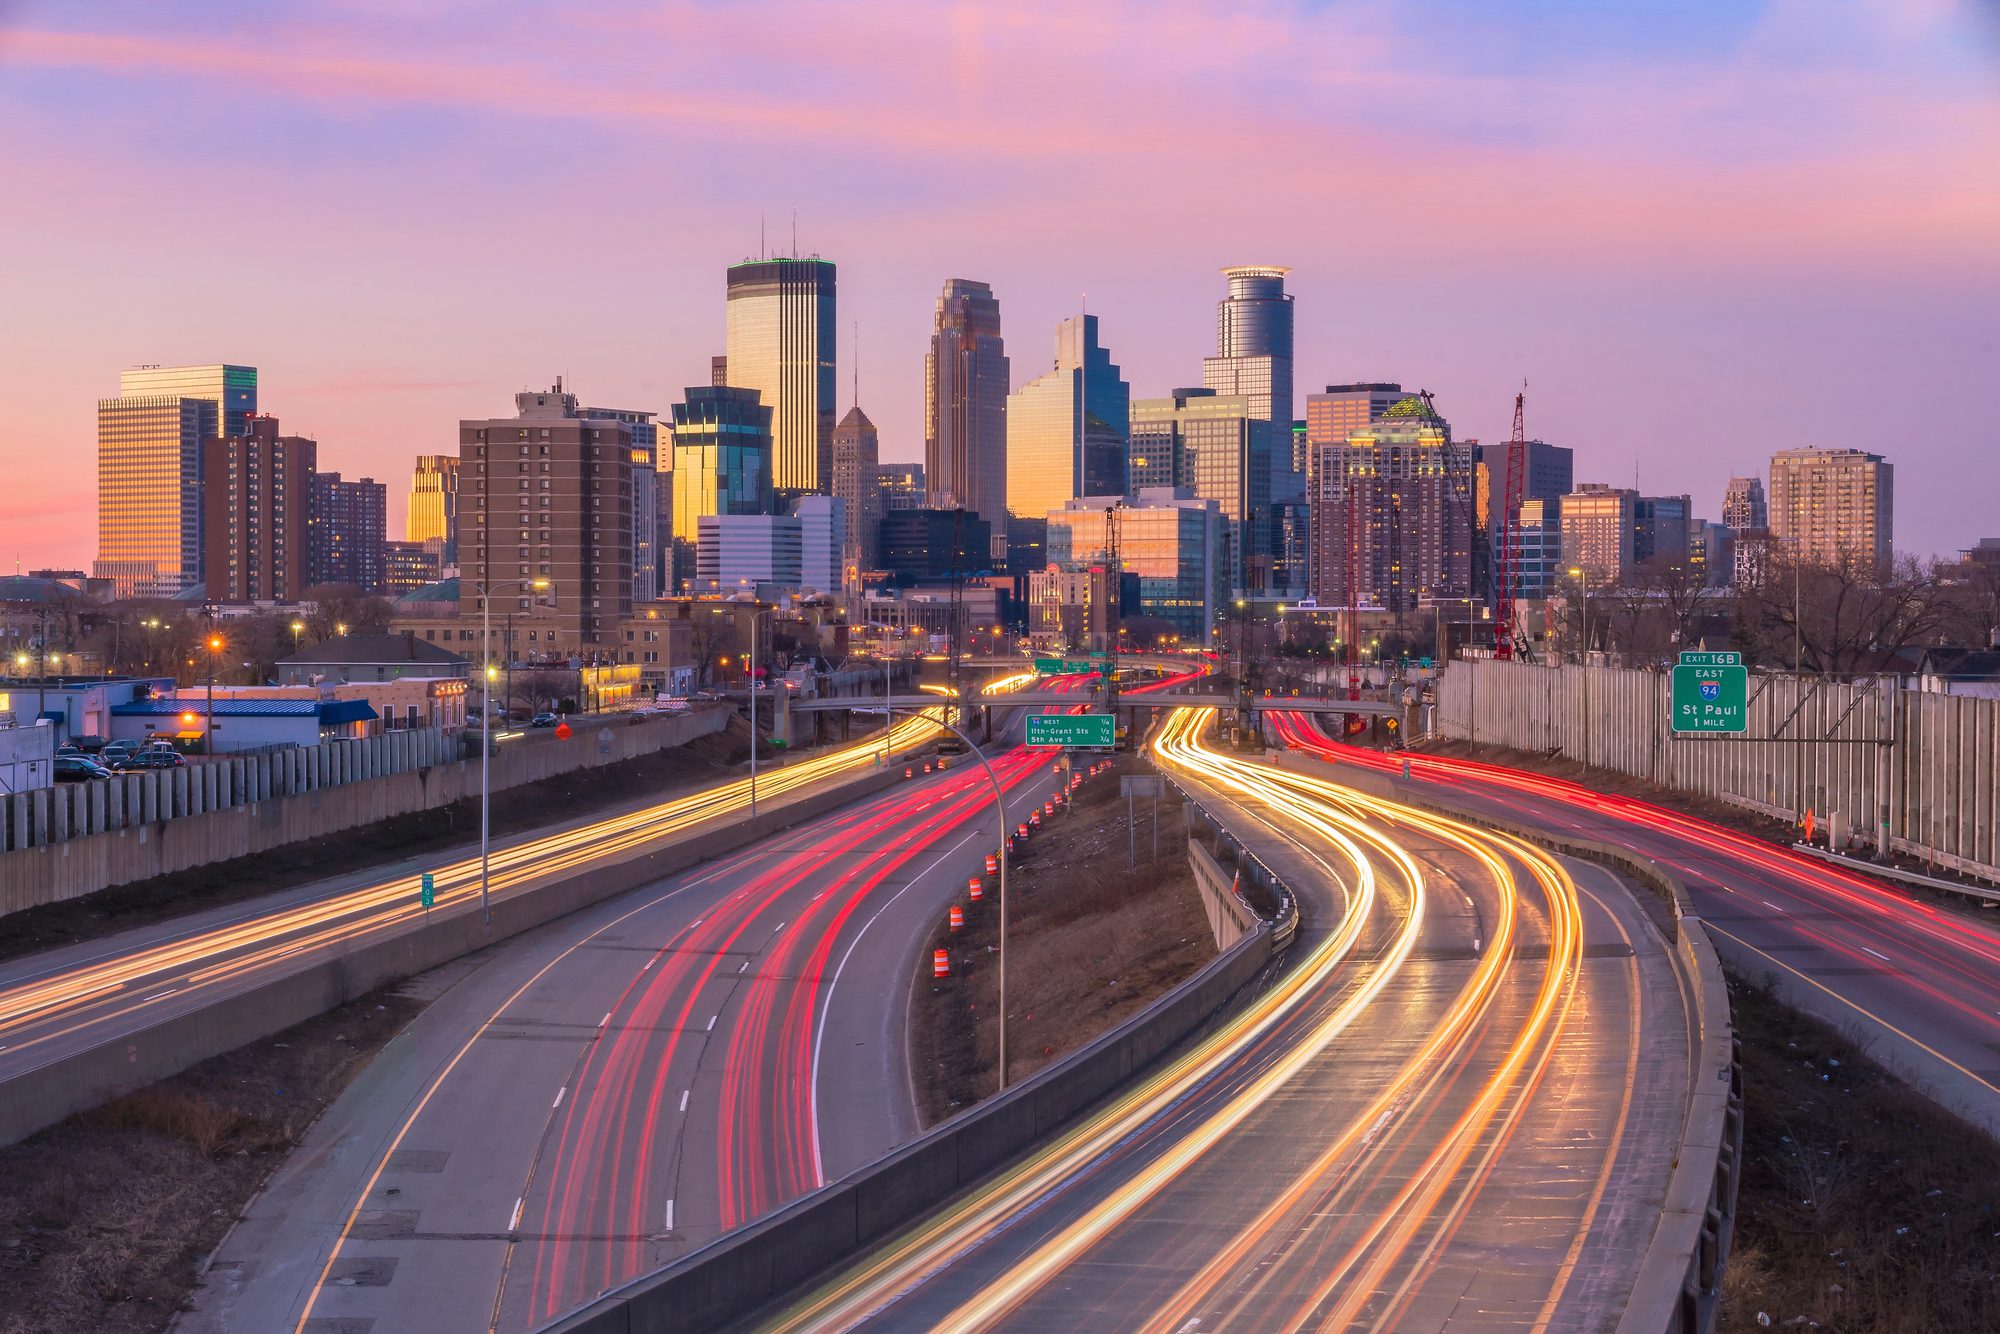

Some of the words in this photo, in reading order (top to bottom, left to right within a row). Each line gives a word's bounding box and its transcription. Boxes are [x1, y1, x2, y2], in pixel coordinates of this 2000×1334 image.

[1712, 654, 1734, 664] 16B
[1702, 686, 1716, 696] 94
[1683, 705, 1697, 714] St
[1706, 705, 1736, 714] Paul
[1694, 718, 1698, 727] 1
